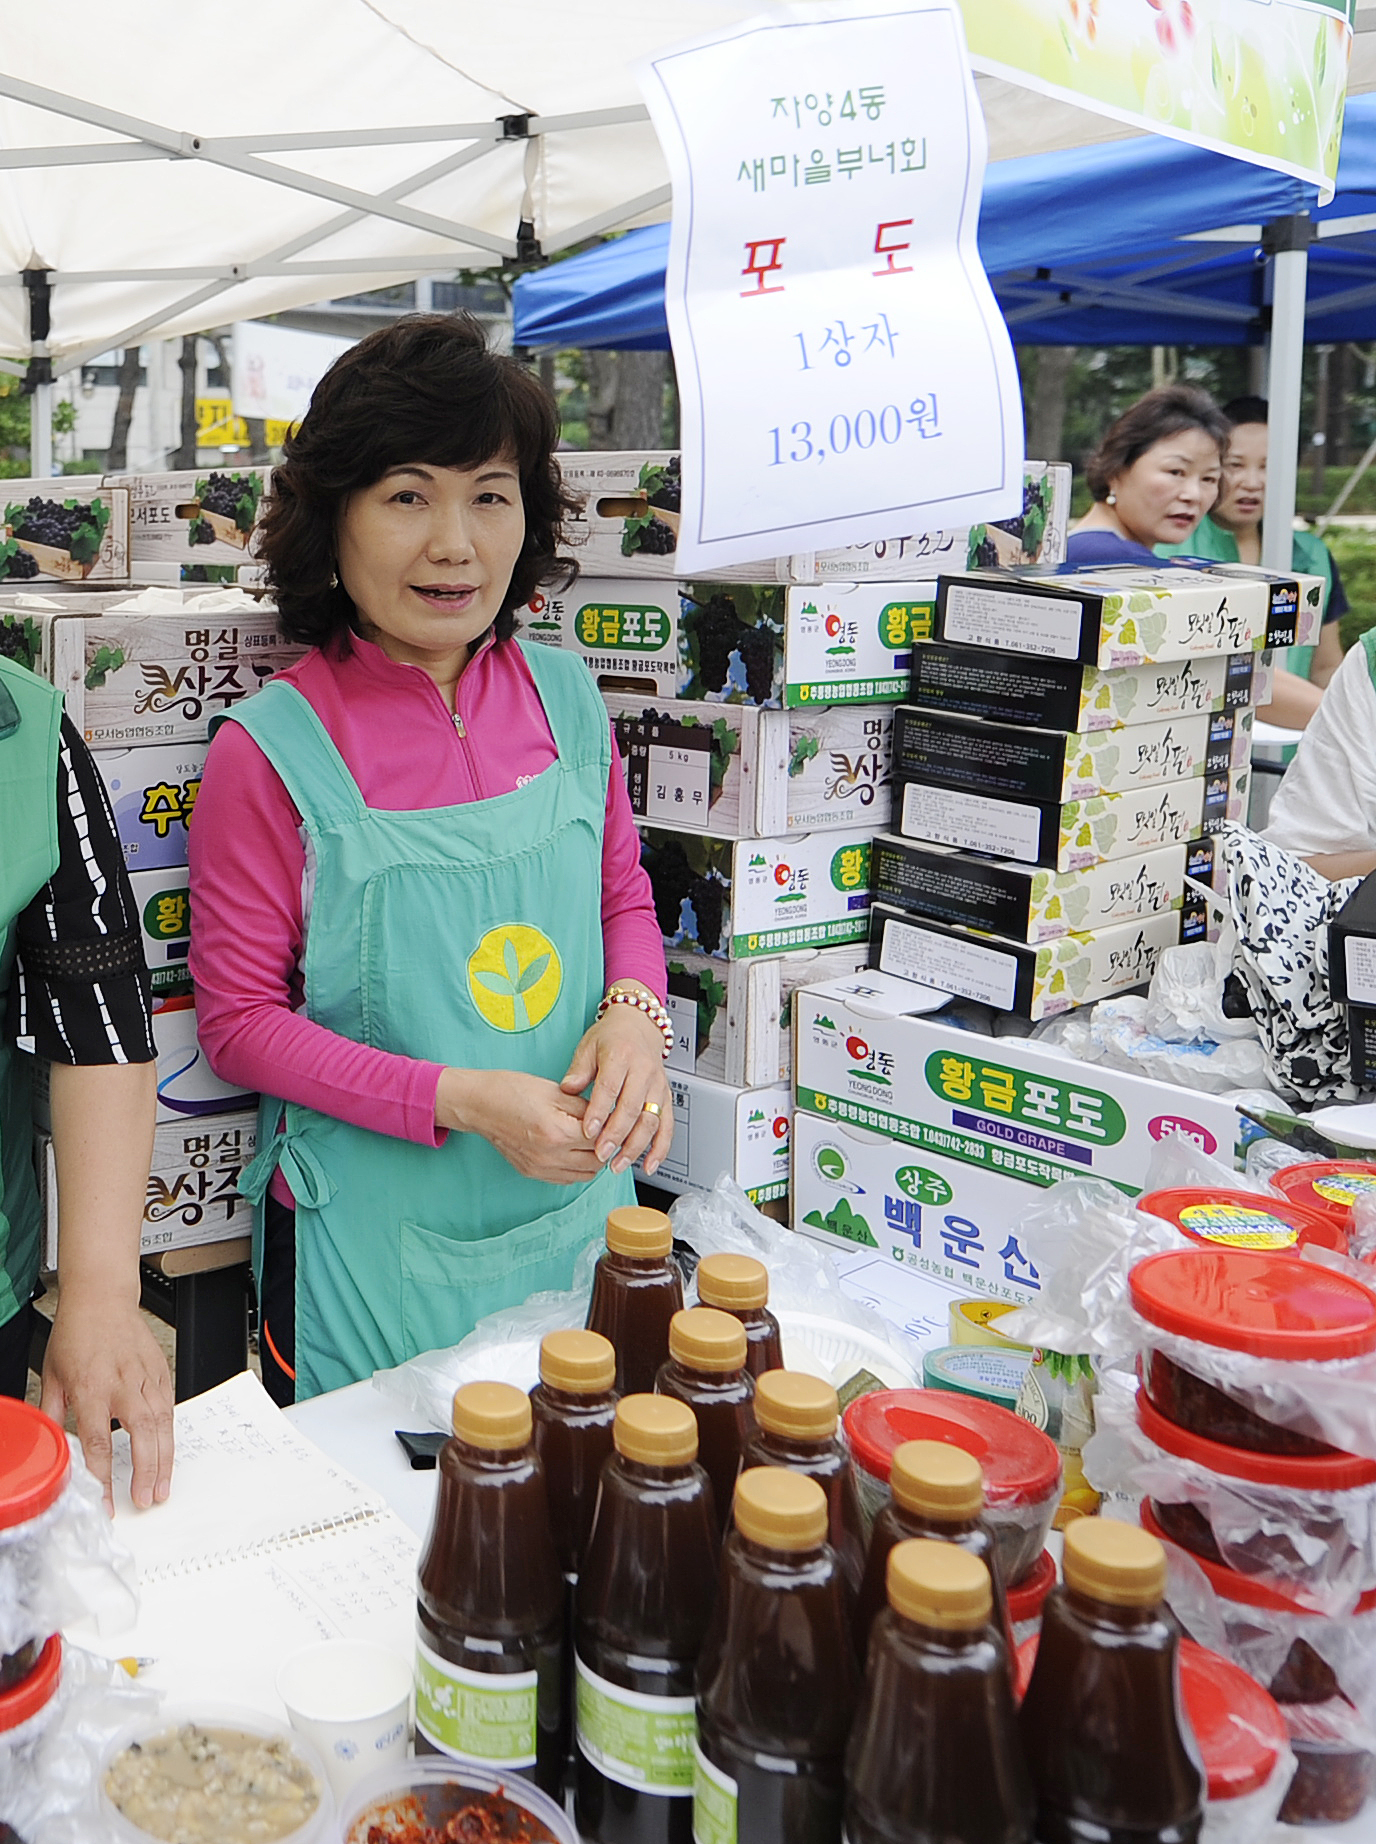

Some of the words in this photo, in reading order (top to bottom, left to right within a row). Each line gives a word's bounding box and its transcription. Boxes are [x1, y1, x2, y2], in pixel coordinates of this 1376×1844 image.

[770, 85, 886, 129] 자양4동
[737, 137, 927, 192] 새마을부녀회
[792, 312, 899, 371] 1상자
[767, 392, 943, 467] 13,000원
[184, 627, 238, 662] 명실
[581, 608, 663, 645] 황금포도
[862, 719, 892, 750] 명
[845, 1035, 895, 1076] 영동
[938, 1056, 1107, 1140] 황금포도
[182, 1129, 241, 1169] 명실
[976, 1119, 1014, 1141] GOLD
[1017, 1130, 1066, 1156] GRAPE
[898, 1168, 949, 1203] 상주
[883, 1194, 1042, 1291] 백운산
